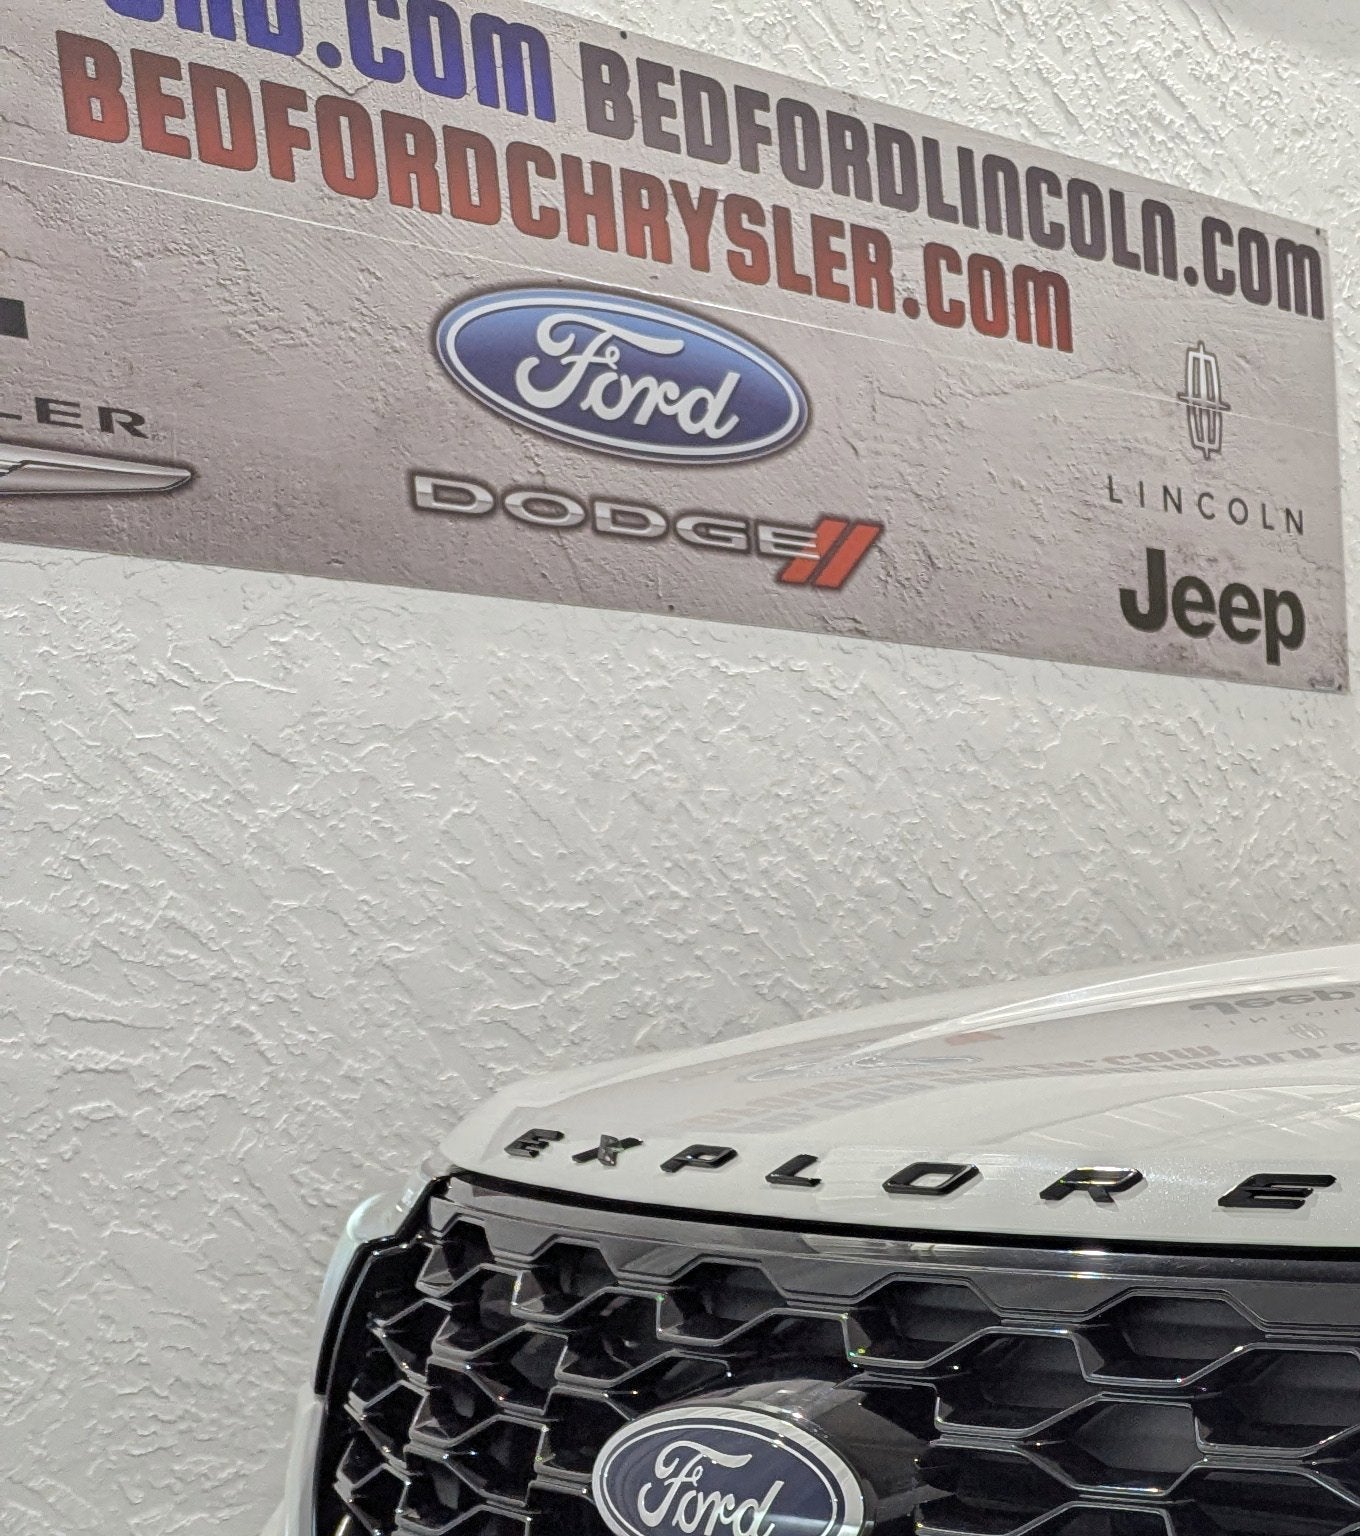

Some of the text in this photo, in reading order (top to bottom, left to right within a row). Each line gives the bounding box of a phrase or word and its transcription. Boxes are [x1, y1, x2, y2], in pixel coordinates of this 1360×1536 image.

[56, 30, 1074, 353] BEDFORDCHRYSLER.COM
[579, 42, 1324, 321] BEDFORDLINCOLN.COM
[514, 312, 740, 440] Ford
[408, 473, 822, 562] DODGE
[1107, 474, 1306, 536] LINCOLN
[1119, 547, 1306, 666] Jeep
